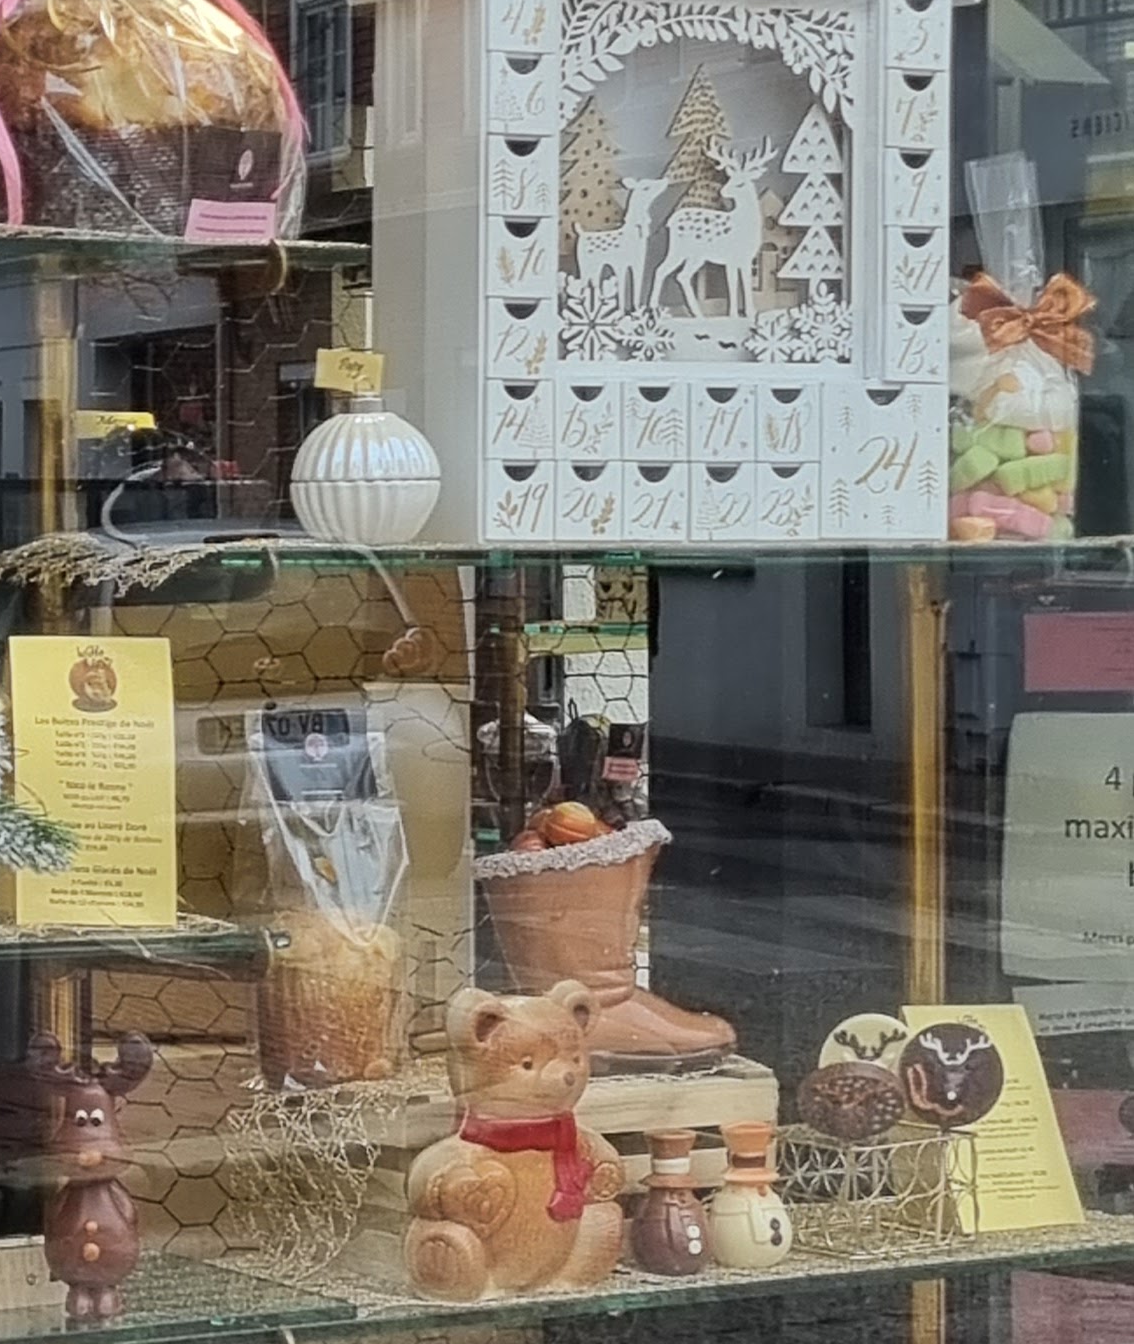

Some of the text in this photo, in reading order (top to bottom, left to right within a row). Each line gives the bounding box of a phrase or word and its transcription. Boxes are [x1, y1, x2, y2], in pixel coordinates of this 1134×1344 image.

[501, 2, 525, 34] 4
[907, 19, 928, 54] 5
[525, 80, 545, 116] 6
[496, 323, 527, 359] 12
[496, 409, 527, 446] 14
[561, 411, 589, 449] 15
[640, 412, 669, 451] 16
[705, 411, 741, 445] 17
[853, 435, 919, 493] 24
[518, 483, 548, 521] 19
[563, 487, 596, 522] 20
[636, 489, 671, 526] 21
[718, 493, 752, 529] 22
[760, 490, 794, 528] 23
[1105, 767, 1122, 791] 4
